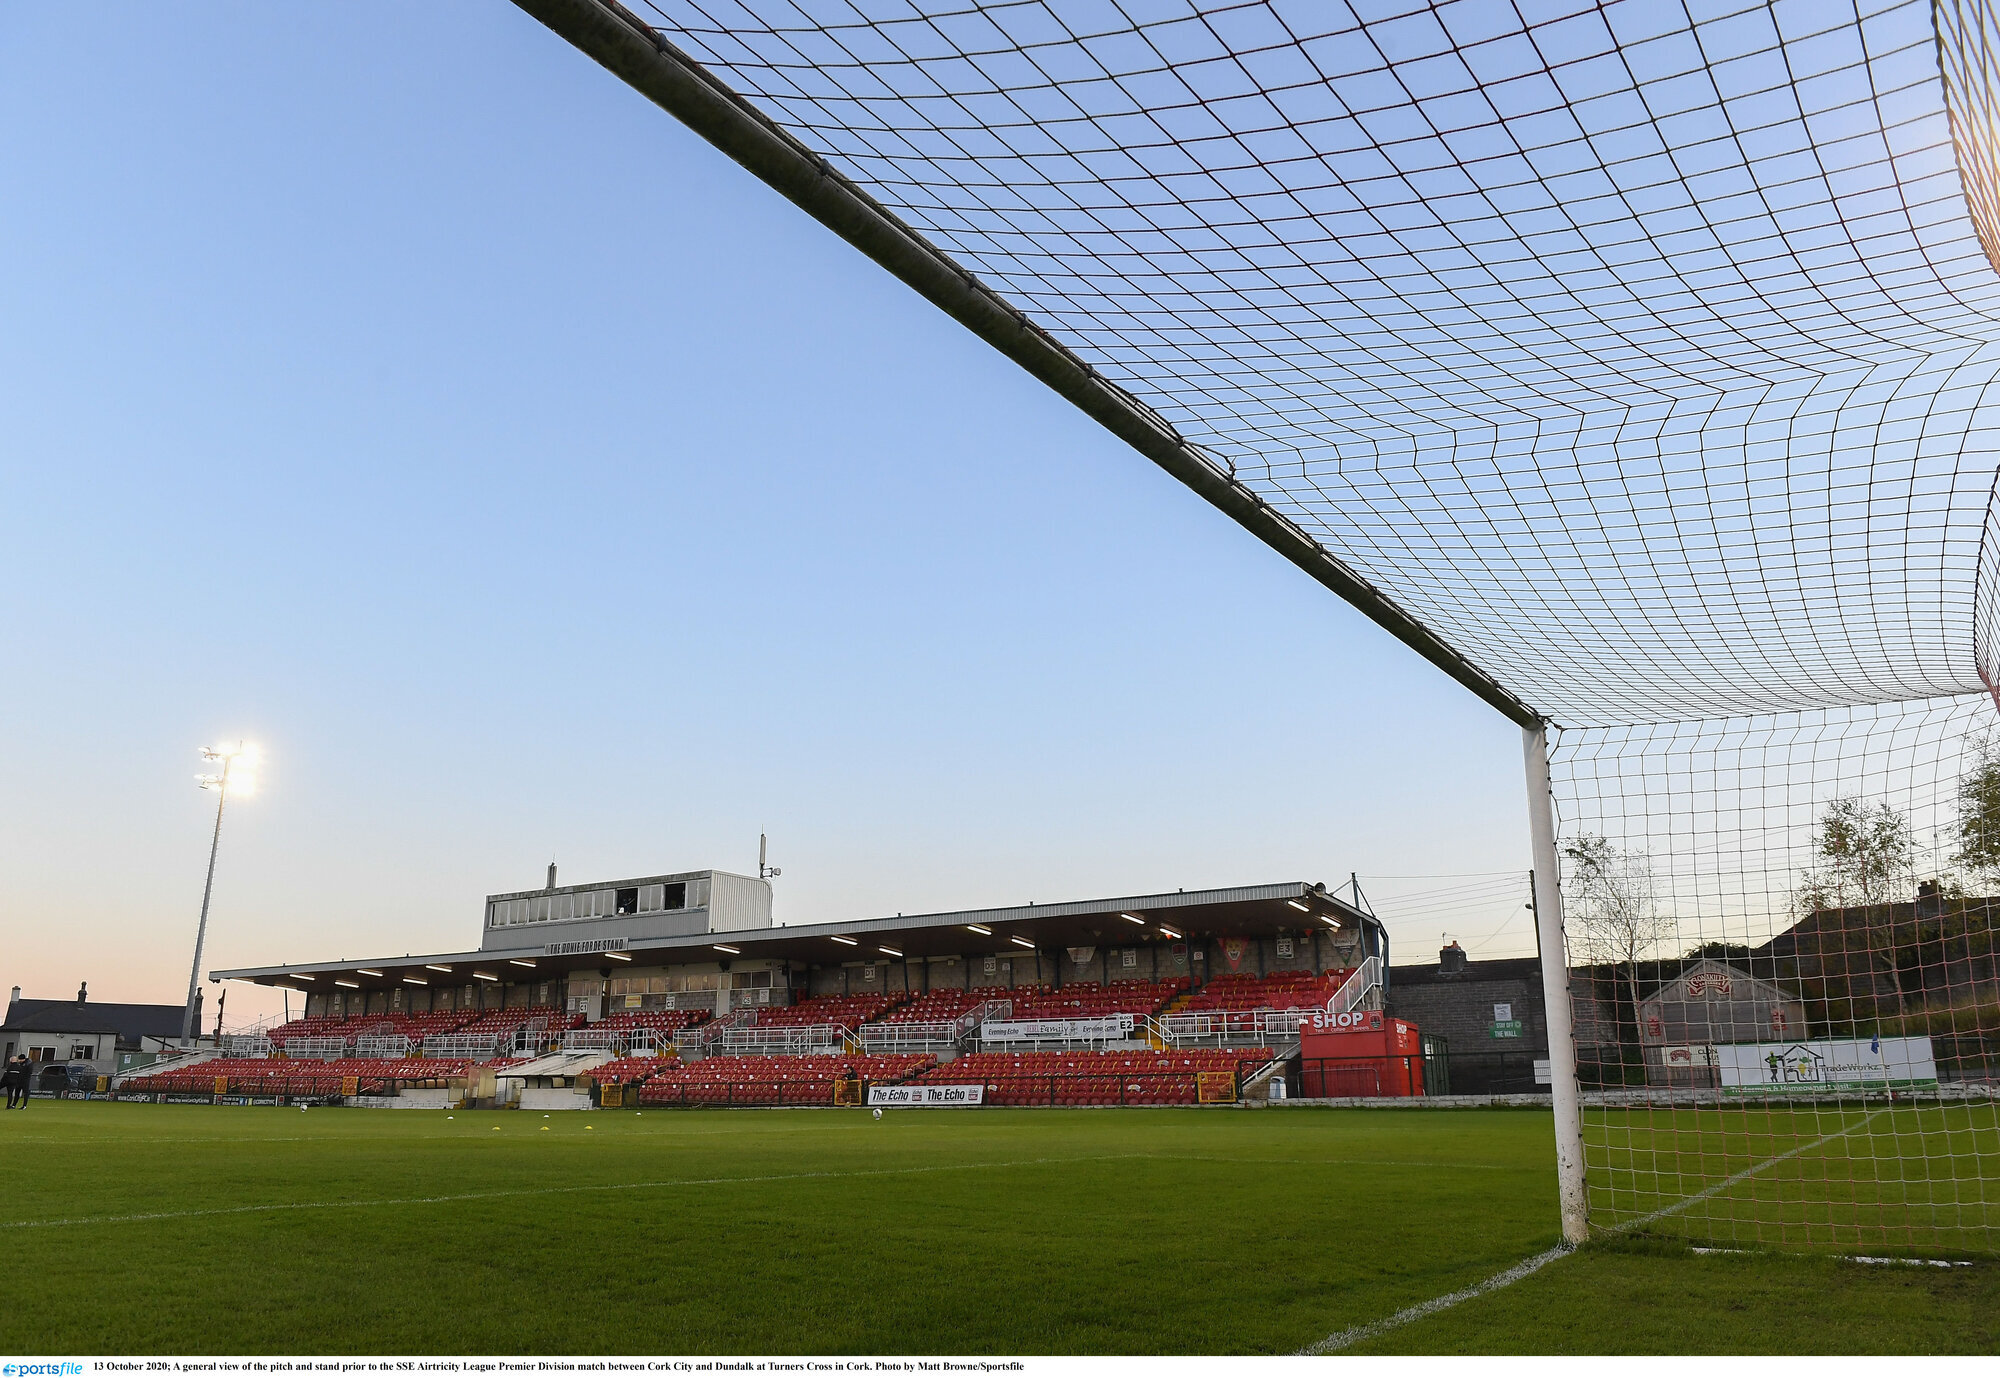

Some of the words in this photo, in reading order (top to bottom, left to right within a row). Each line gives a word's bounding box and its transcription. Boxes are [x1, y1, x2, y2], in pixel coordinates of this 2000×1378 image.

[550, 943, 561, 954] THE
[562, 942, 580, 953] DONIE
[582, 940, 601, 952] FORDE
[602, 939, 624, 951] STAND
[984, 962, 995, 970] D3
[865, 969, 874, 977] D1
[1120, 1021, 1132, 1029] E2
[1313, 1012, 1364, 1029] SHOP
[1040, 1022, 1068, 1035] Family
[1820, 1063, 1890, 1072] TradeWorkz.e
[873, 1089, 887, 1100] The
[889, 1089, 909, 1100] Echo
[927, 1089, 942, 1100] The
[945, 1088, 965, 1100] Echo
